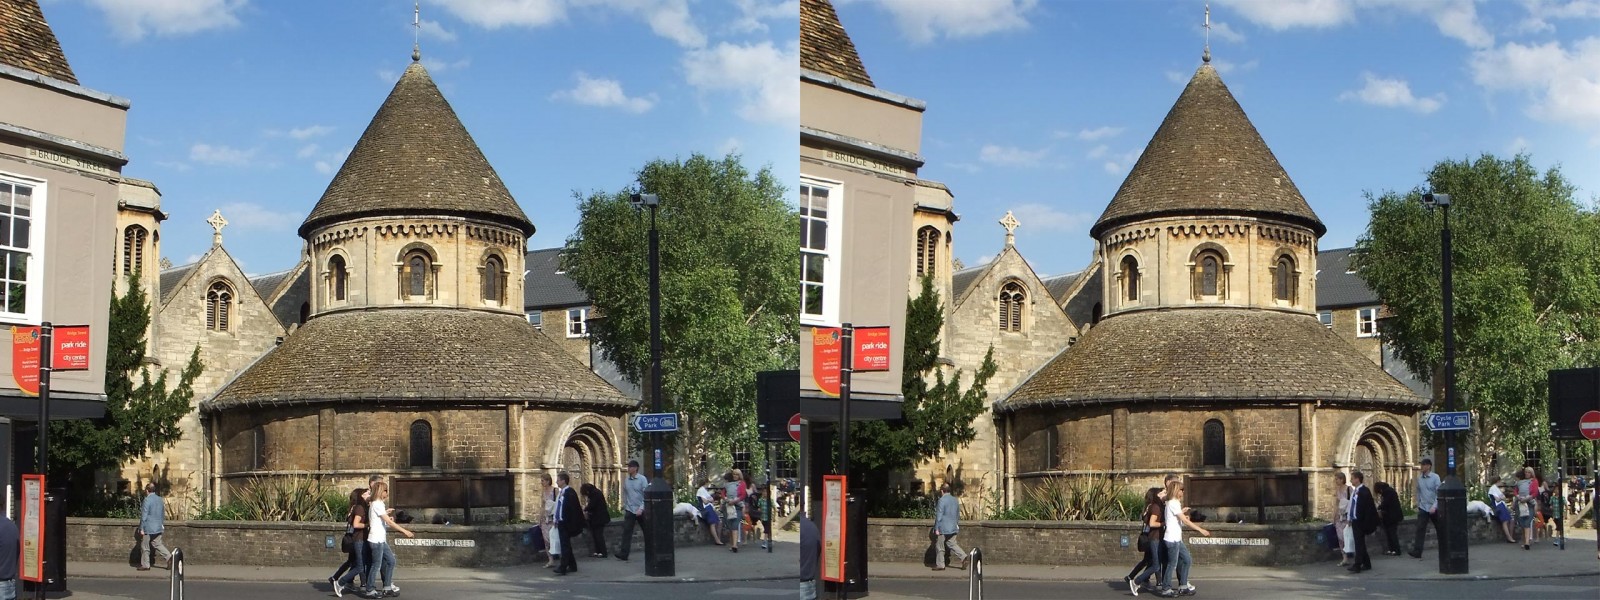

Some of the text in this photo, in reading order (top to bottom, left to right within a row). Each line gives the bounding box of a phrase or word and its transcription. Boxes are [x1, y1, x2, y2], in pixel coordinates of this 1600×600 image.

[38, 149, 106, 172] BRIDGE STREET
[835, 152, 903, 174] BRIDGE STREET
[61, 340, 87, 350] park ride
[861, 341, 888, 351] park ride
